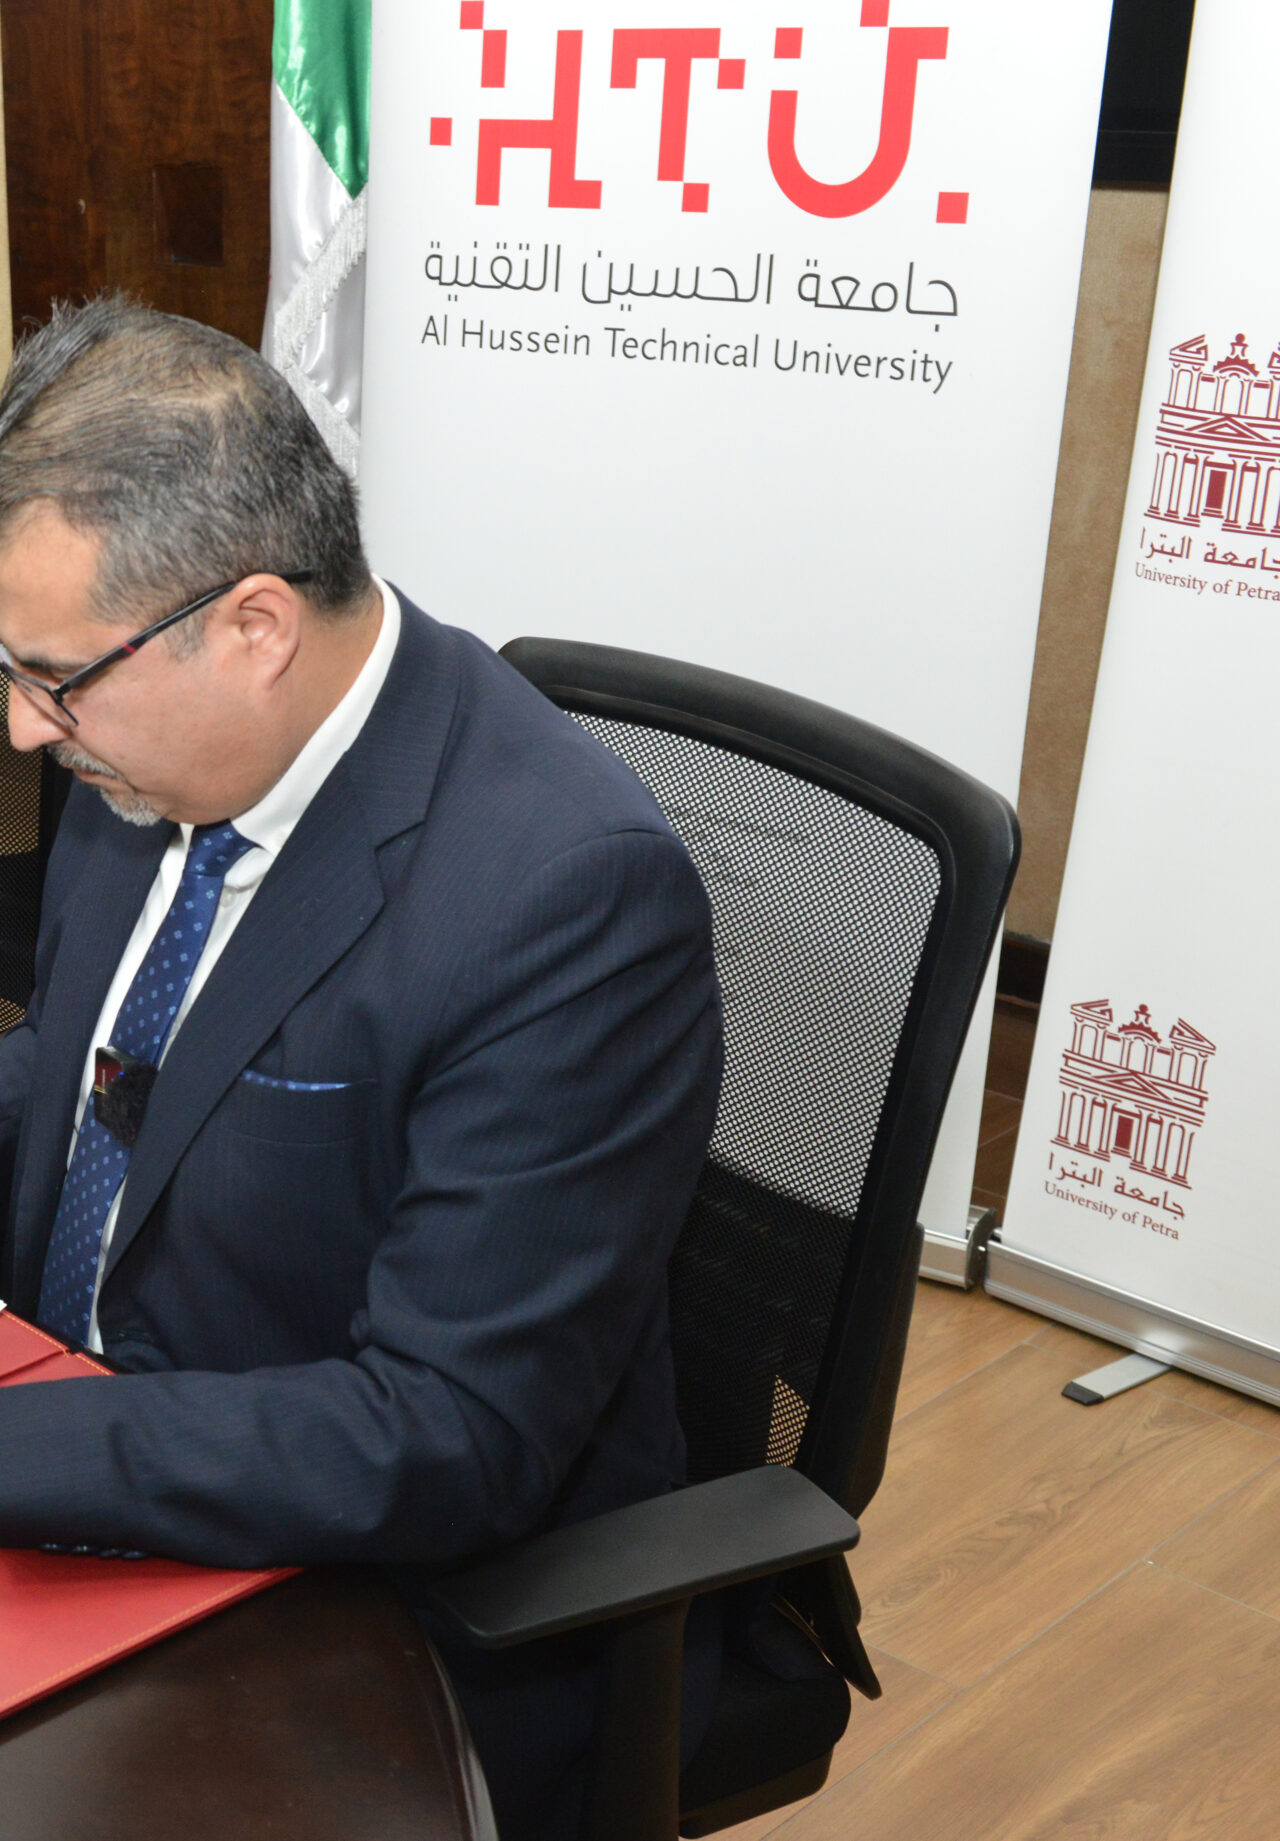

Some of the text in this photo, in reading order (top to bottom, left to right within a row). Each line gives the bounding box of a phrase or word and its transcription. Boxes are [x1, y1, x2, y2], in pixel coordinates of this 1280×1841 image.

[425, 241, 959, 332] جامعة الحسين التقنية
[421, 314, 953, 395] Al Hussein Technical University
[1140, 526, 1192, 563] البترا
[1135, 562, 1280, 601] University of Petra
[1044, 1181, 1180, 1240] University of Petra
[1048, 1152, 1185, 1220] جامعة البترا
